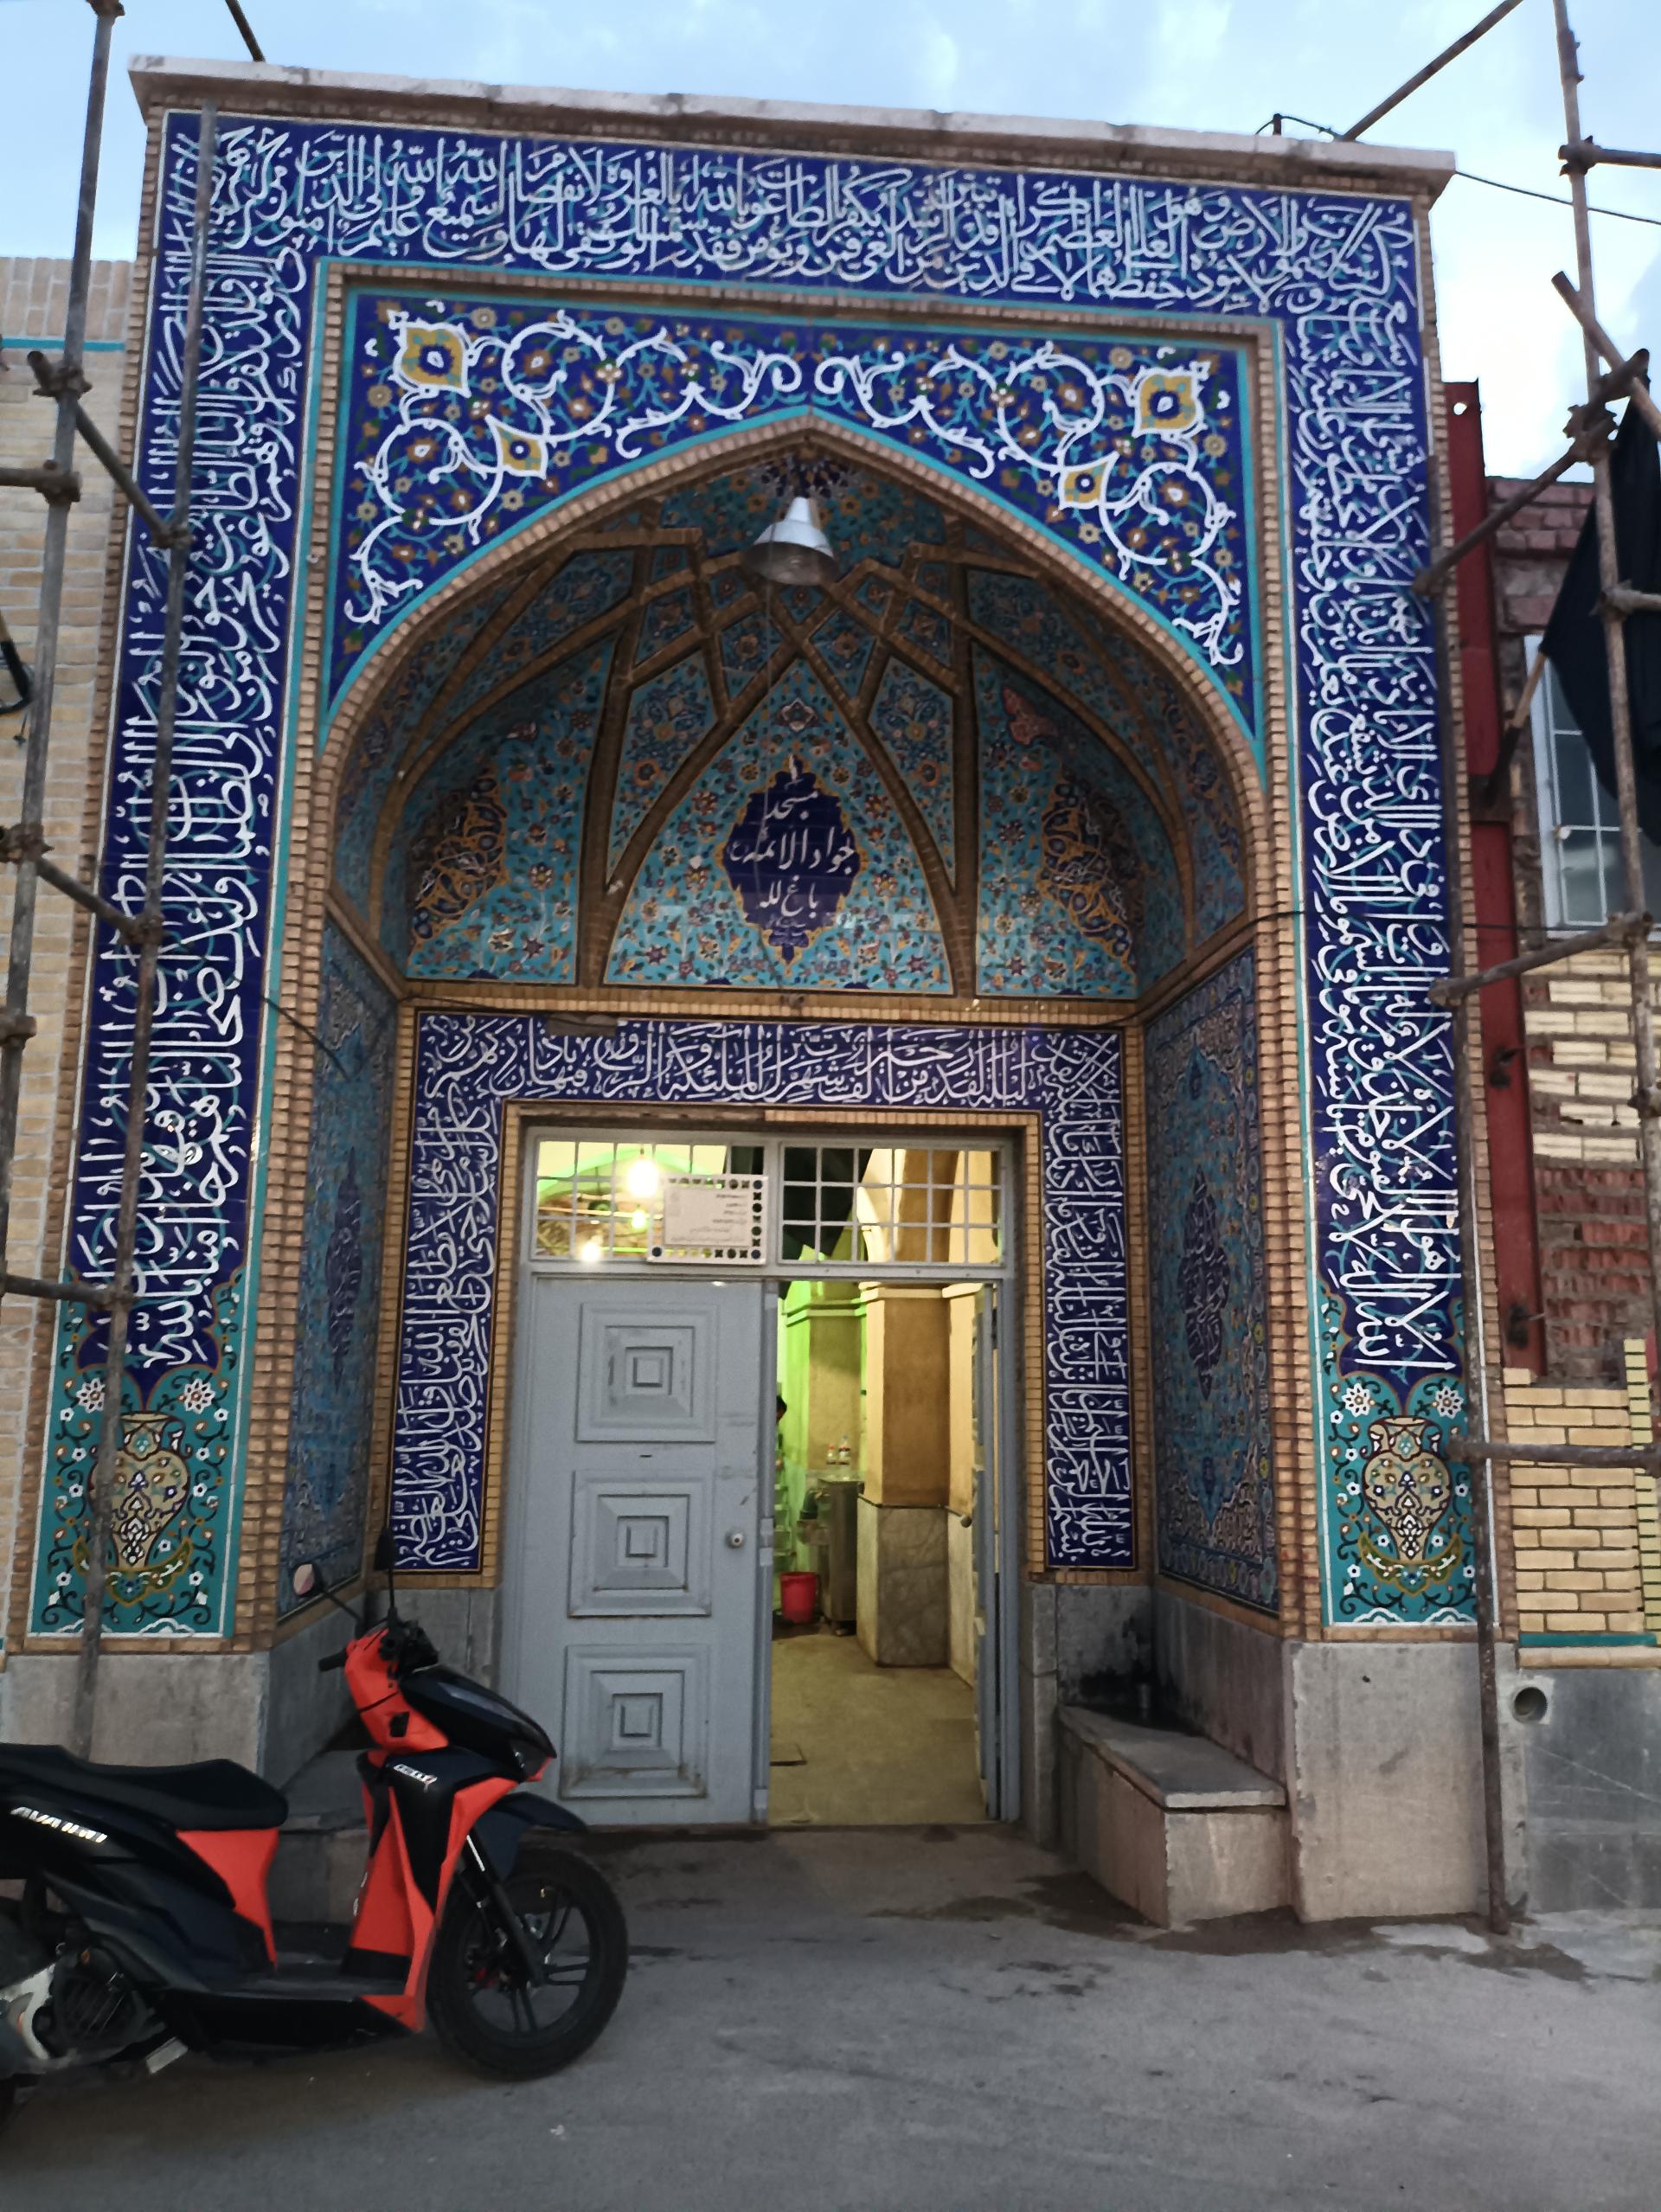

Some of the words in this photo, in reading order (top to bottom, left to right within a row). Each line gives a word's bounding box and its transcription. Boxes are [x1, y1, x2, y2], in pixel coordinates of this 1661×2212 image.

[764, 791, 819, 820] مسجد
[808, 827, 855, 875] جواد
[781, 875, 819, 919] باغ
